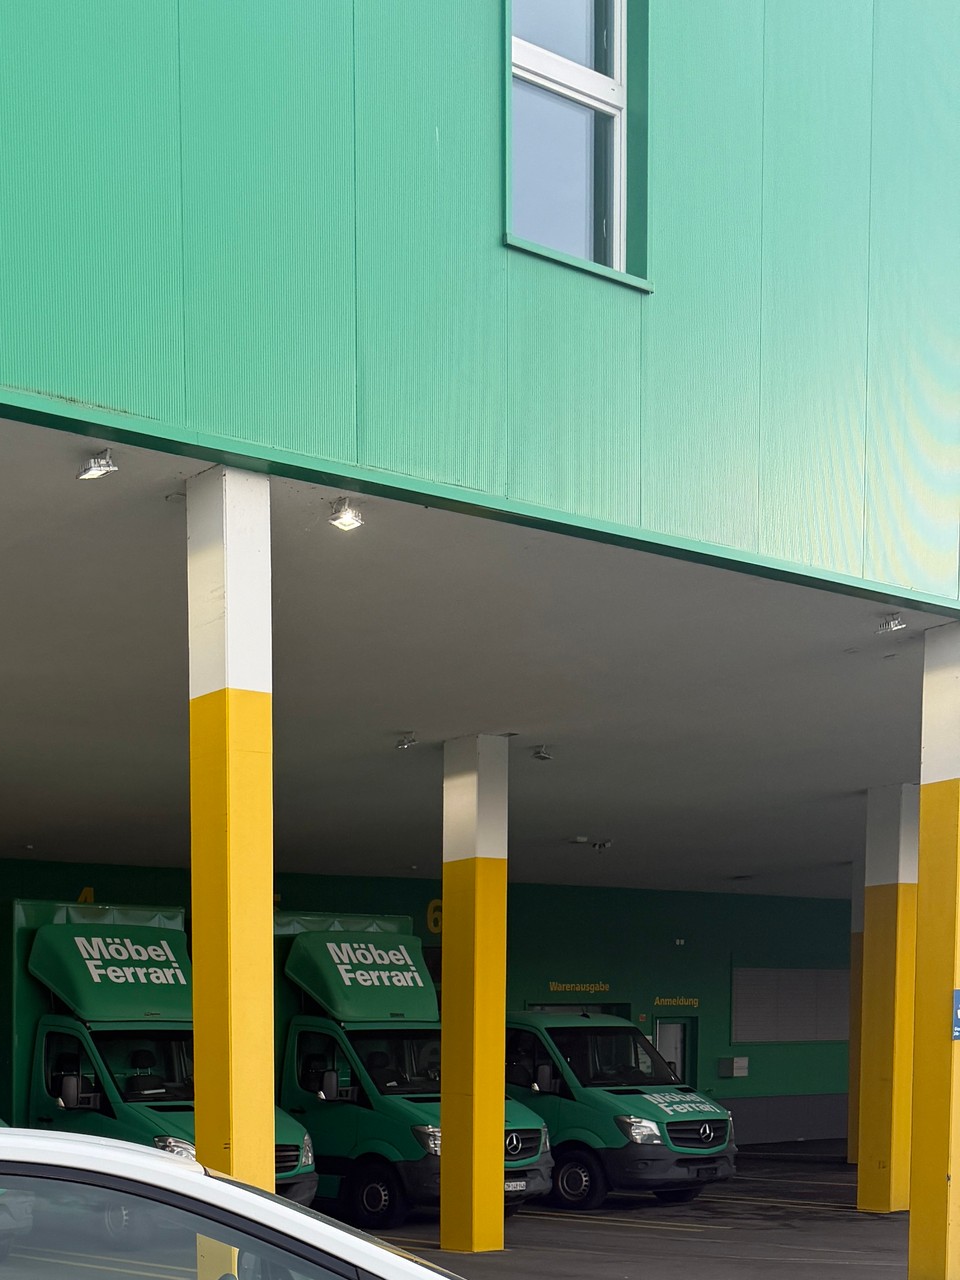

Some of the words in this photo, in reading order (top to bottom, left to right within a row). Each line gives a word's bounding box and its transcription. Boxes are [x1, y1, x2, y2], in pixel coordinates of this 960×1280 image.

[426, 898, 442, 934] 6
[74, 937, 177, 961] Möbel
[326, 943, 413, 965] Möbel
[85, 960, 187, 985] Ferrari
[337, 964, 424, 987] Ferrari
[549, 981, 610, 993] Warenausgabe
[654, 996, 699, 1007] Anmeldung
[642, 1092, 709, 1105] Möbel
[658, 1102, 721, 1115] Ferrari
